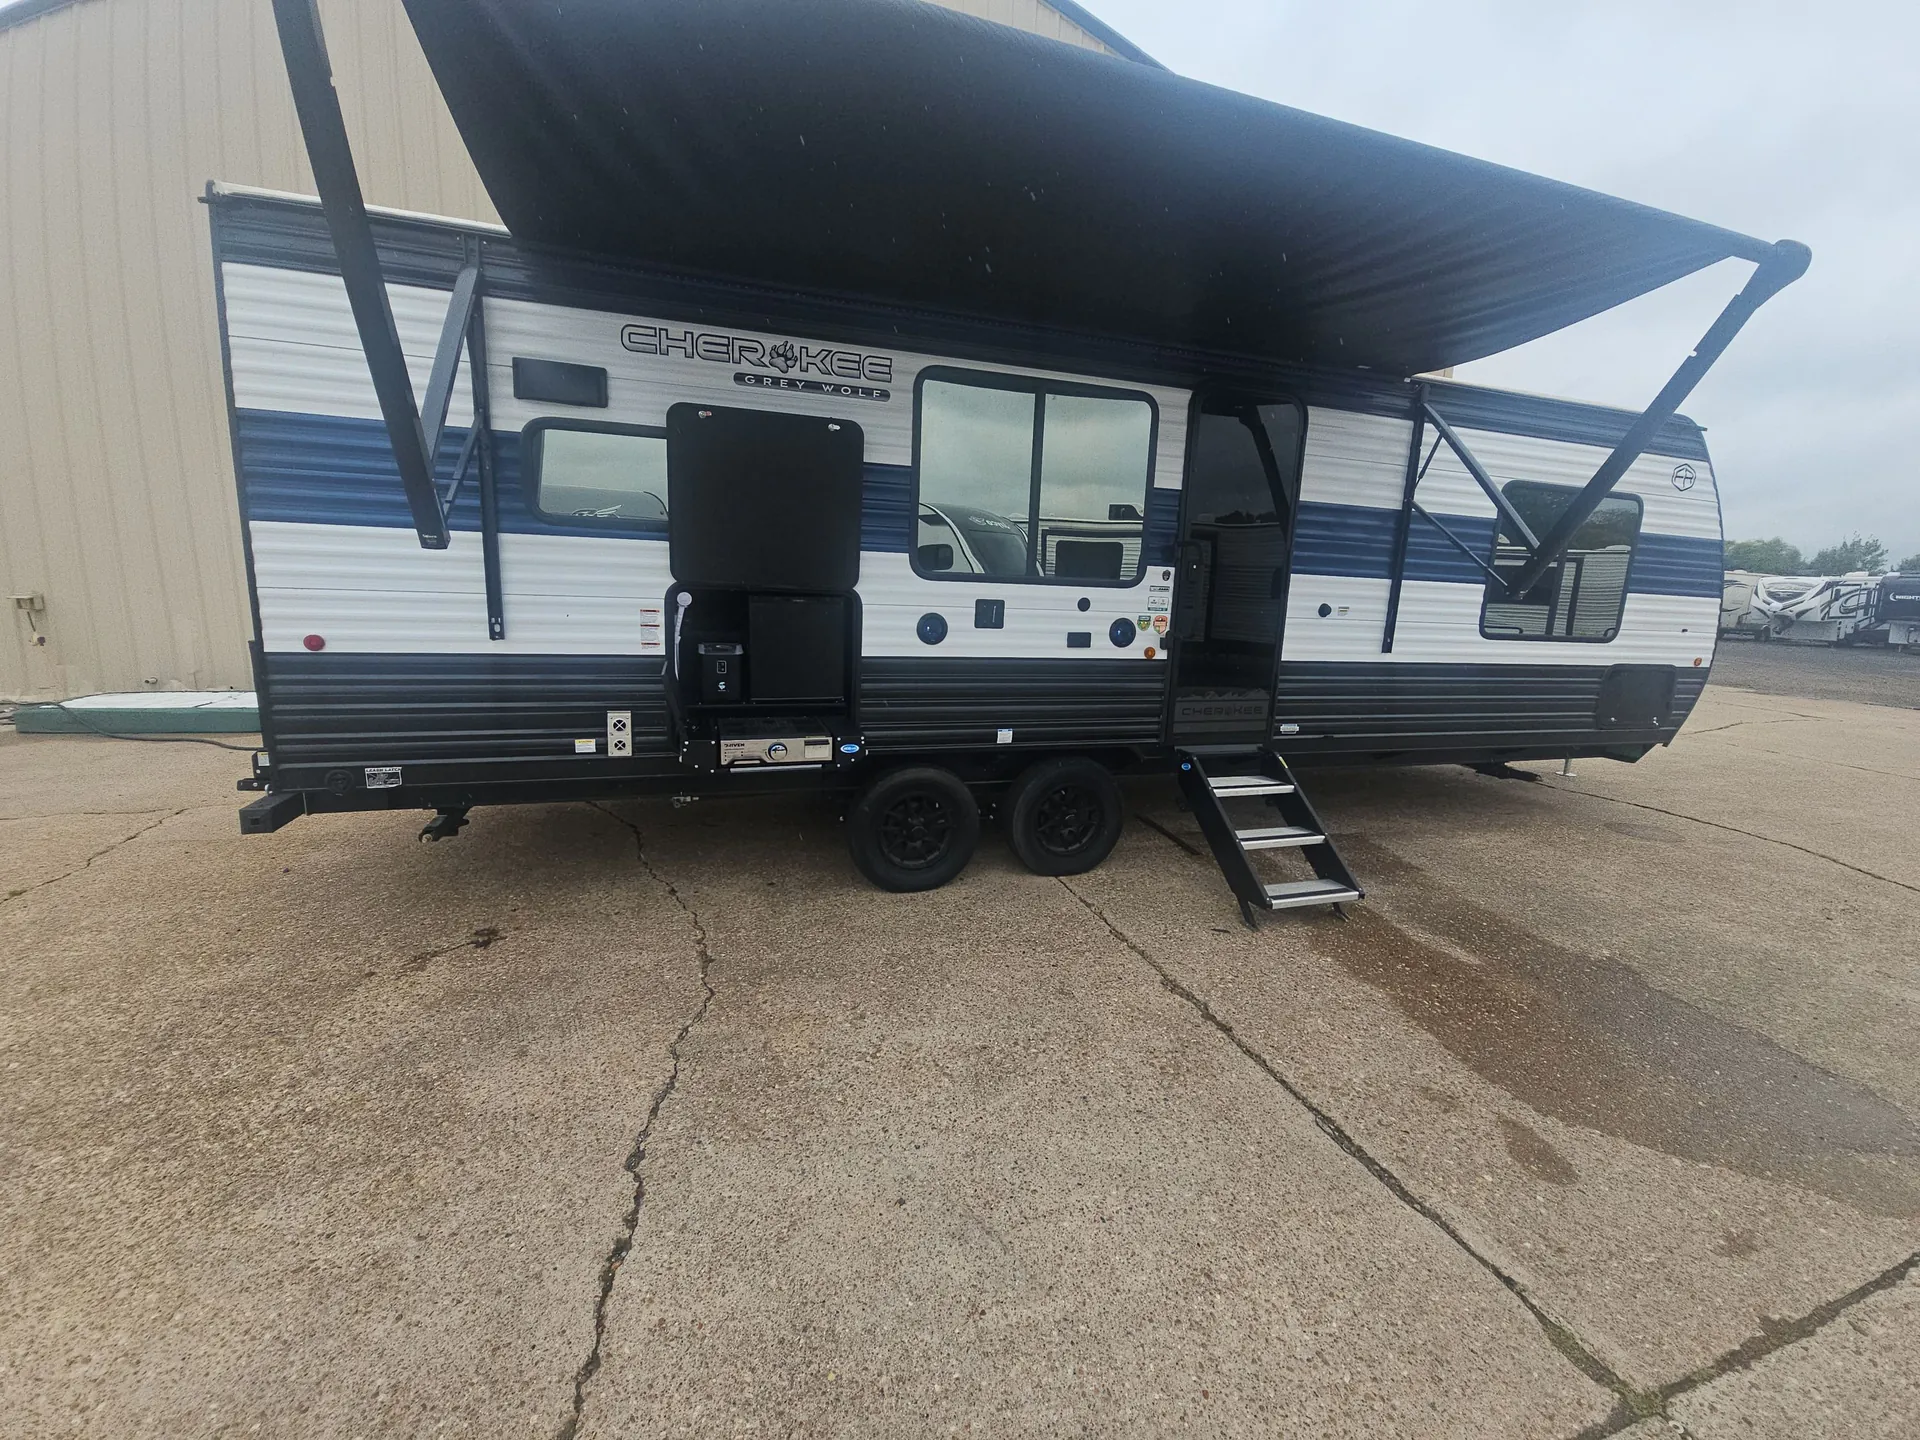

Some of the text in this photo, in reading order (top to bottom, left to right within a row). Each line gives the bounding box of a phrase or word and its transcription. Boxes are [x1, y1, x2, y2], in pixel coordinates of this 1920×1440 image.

[621, 323, 892, 383] CHEROKEE
[744, 375, 882, 399] GREY WOLF
[1181, 705, 1264, 717] CHEROKEE
